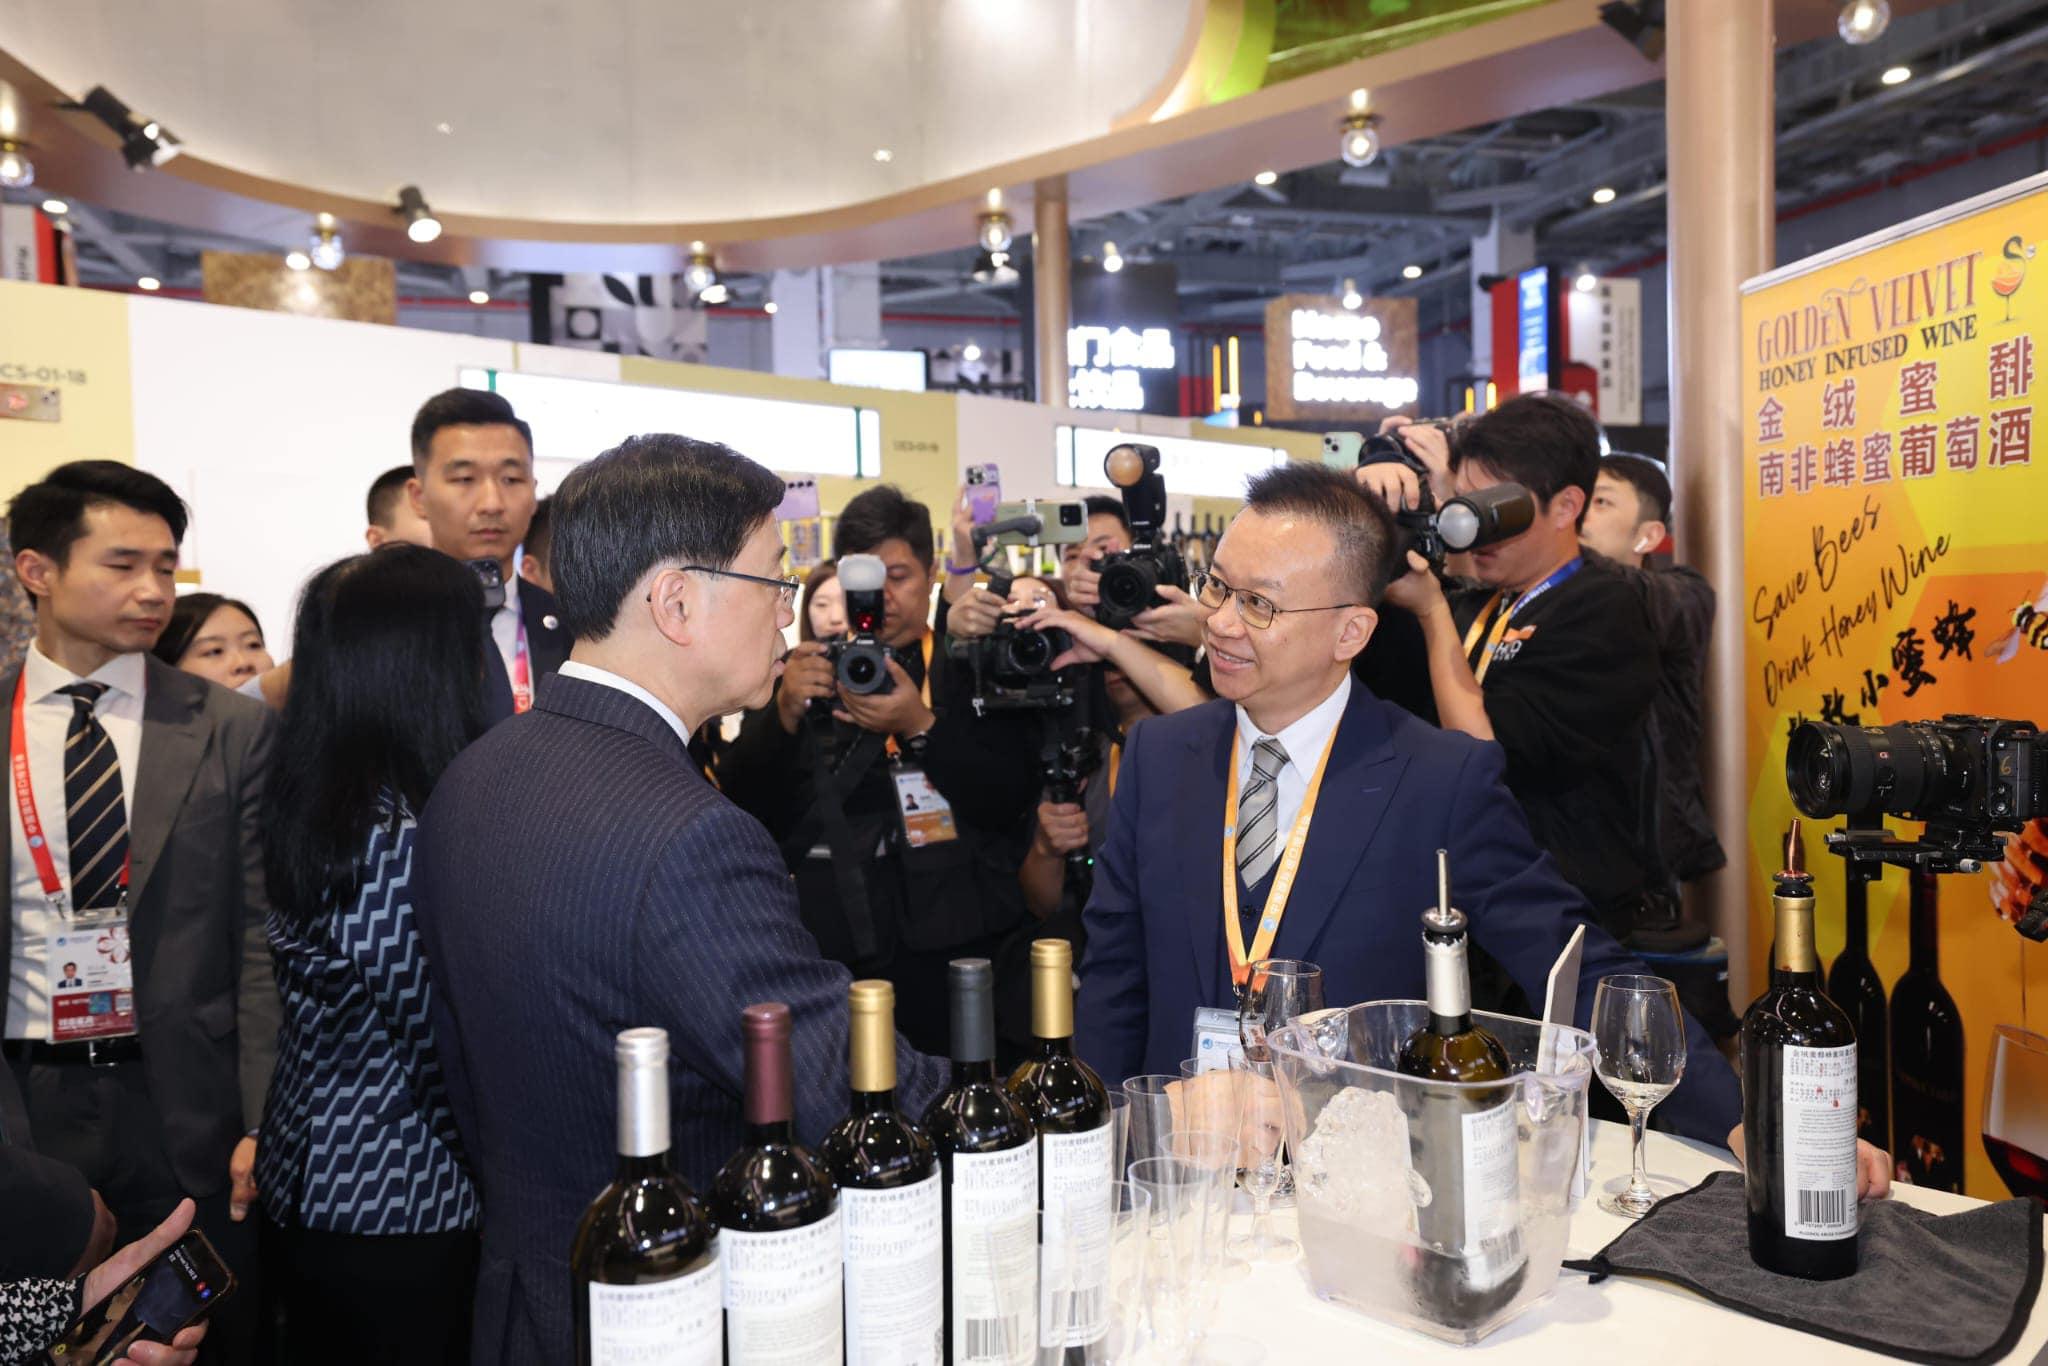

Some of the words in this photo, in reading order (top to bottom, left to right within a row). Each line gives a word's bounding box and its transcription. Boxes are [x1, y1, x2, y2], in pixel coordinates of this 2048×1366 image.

[1870, 251, 1984, 333] VELVET
[1759, 356, 1817, 391] HONEY
[1825, 333, 1908, 375] INFUSED
[1920, 314, 1978, 349] WINE
[1758, 406, 2033, 497] 南非蜂蜜葡萄酒
[1753, 569, 1809, 640] Save
[1812, 494, 1880, 592] Bees
[1763, 635, 1815, 708] Drink
[1819, 591, 1878, 658] Honey
[1880, 533, 1951, 610] Wine
[2001, 756, 2012, 775] 6
